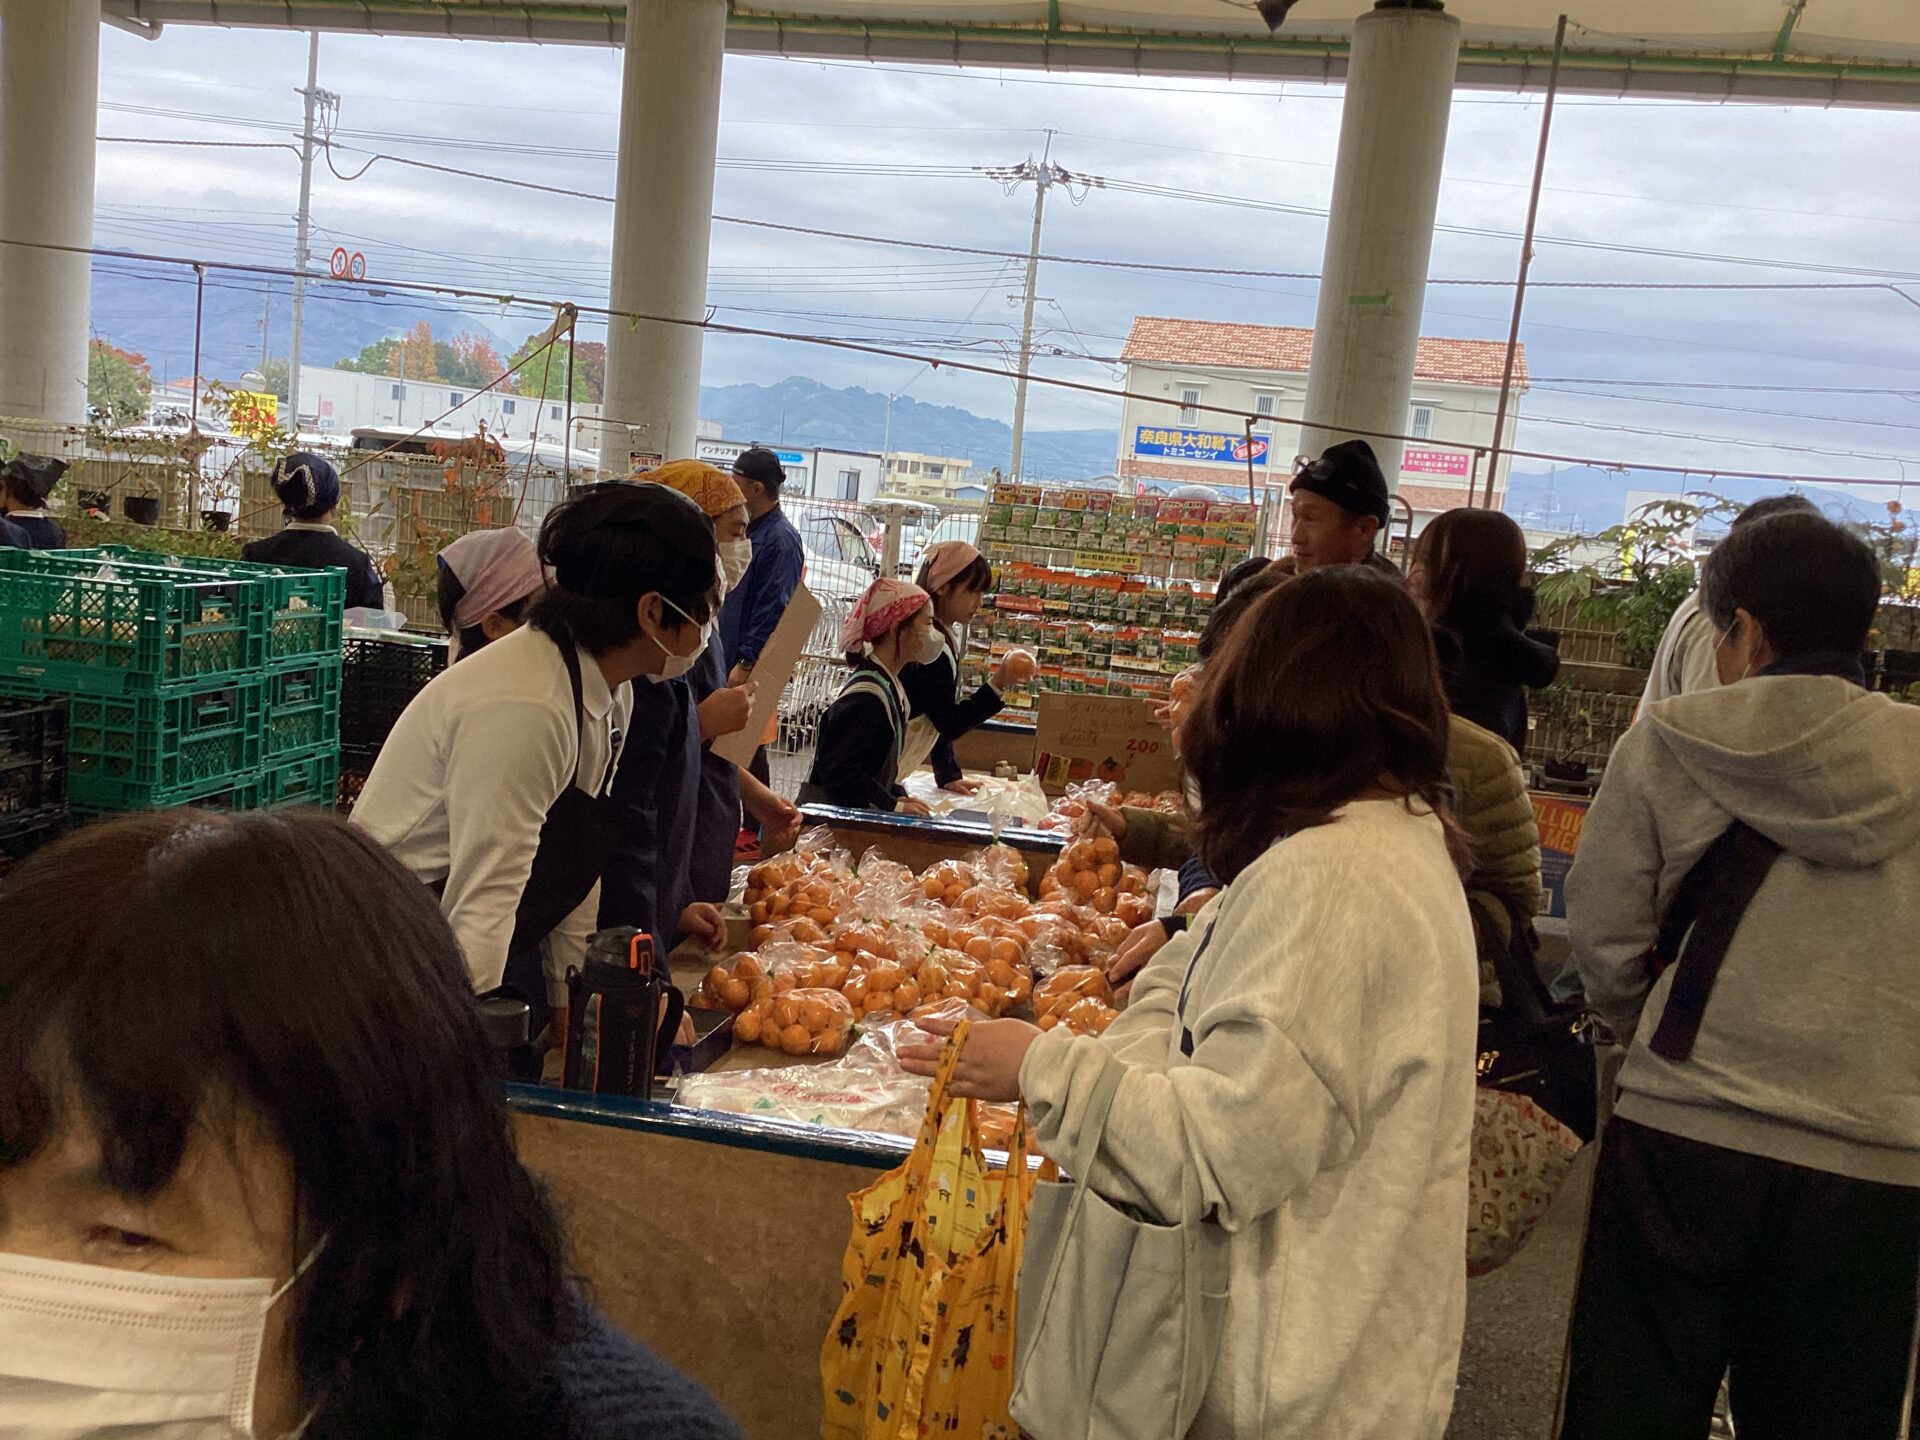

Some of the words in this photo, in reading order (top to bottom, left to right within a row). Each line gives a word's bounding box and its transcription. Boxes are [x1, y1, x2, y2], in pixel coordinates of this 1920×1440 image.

[1139, 429, 1241, 452] 奈良県大和靴下
